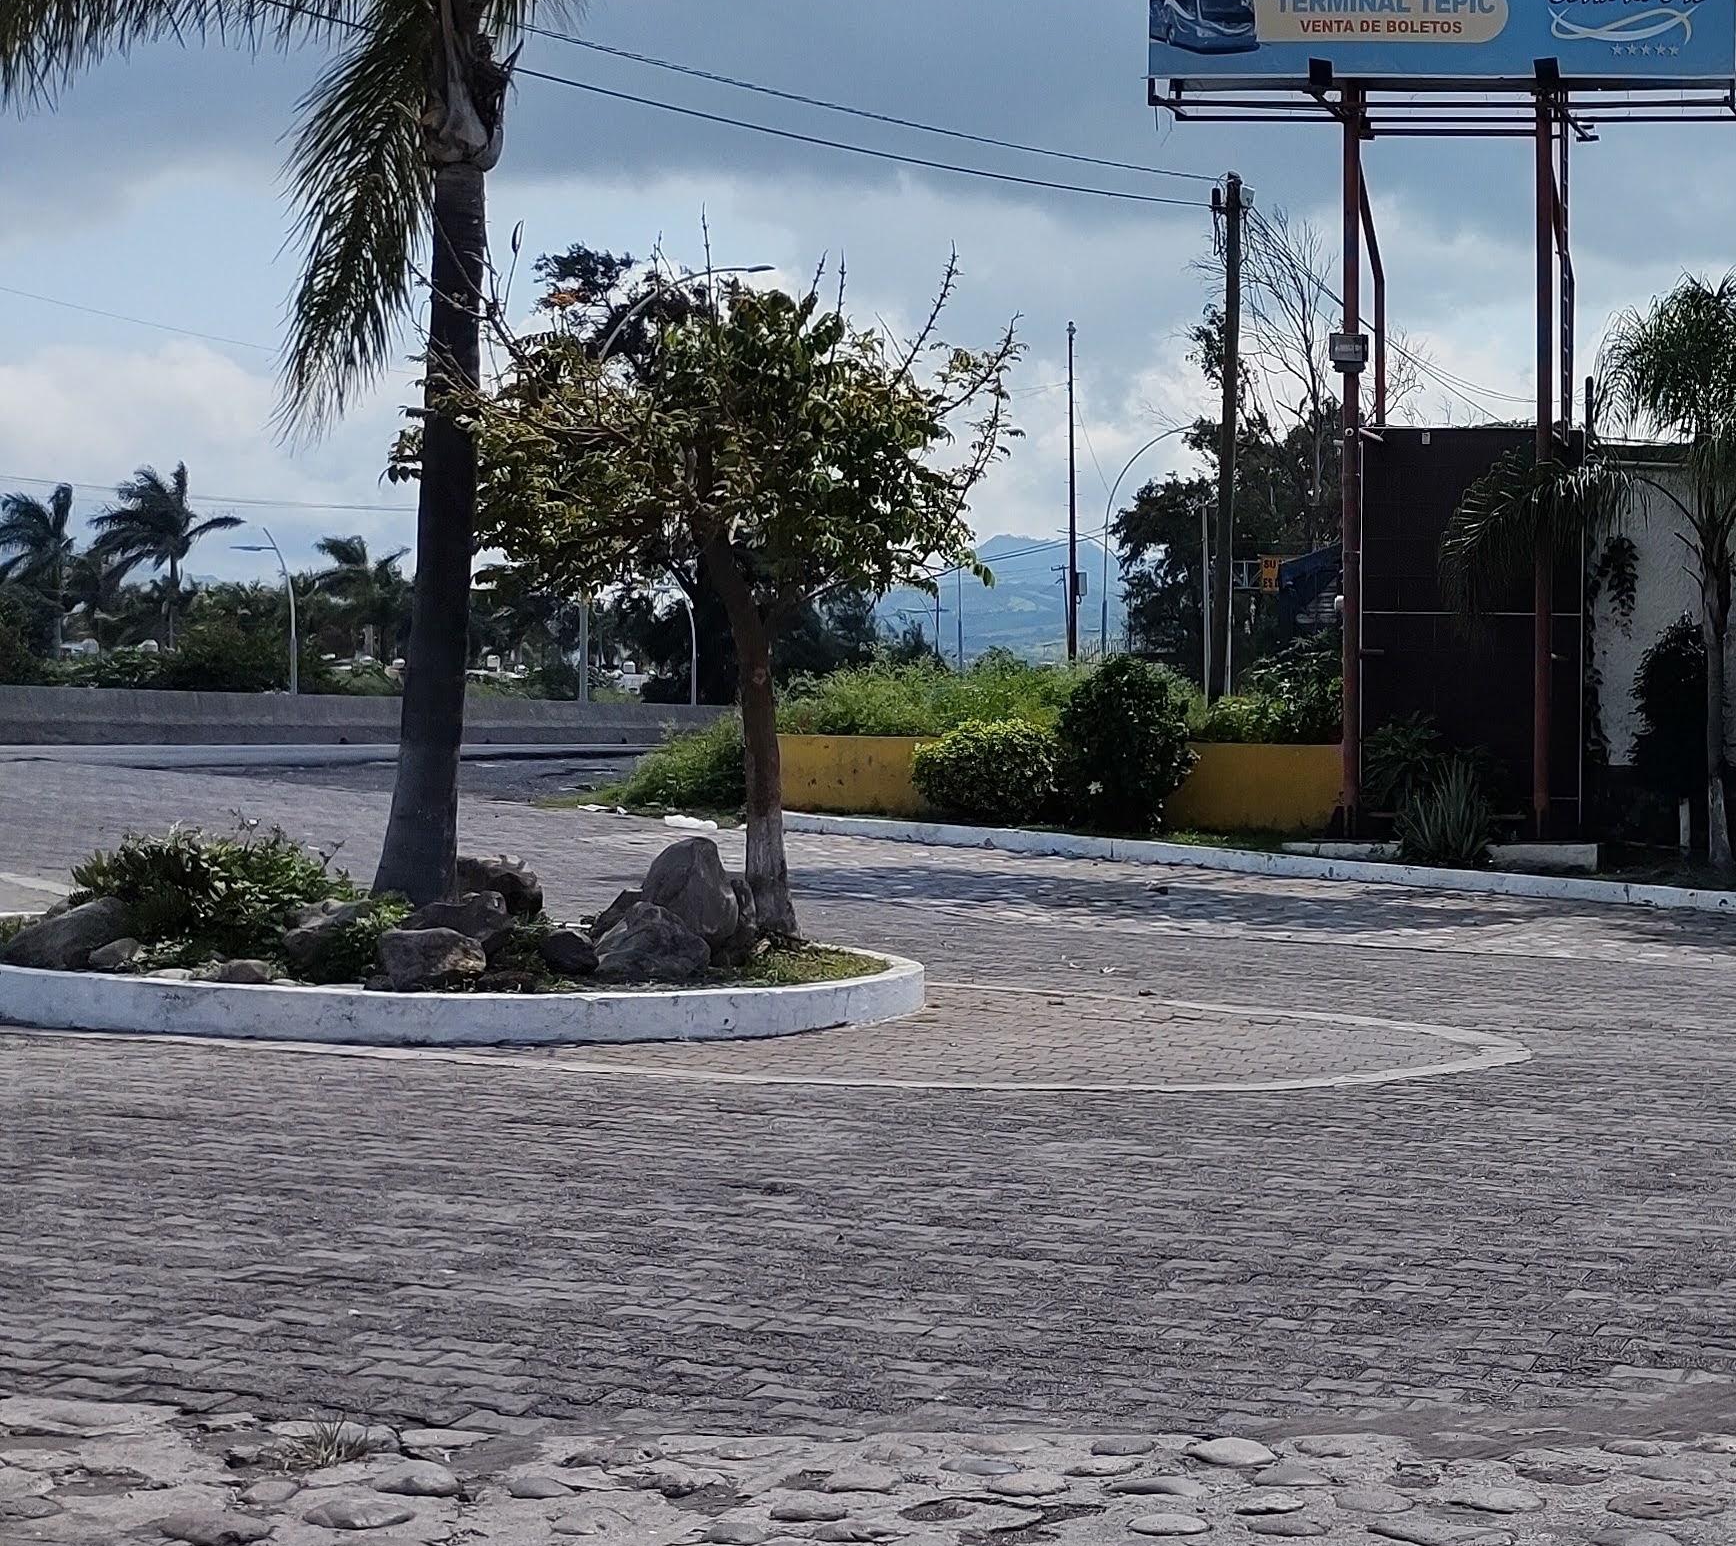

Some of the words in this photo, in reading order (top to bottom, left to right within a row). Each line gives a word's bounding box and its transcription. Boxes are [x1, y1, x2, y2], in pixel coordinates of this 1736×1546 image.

[1299, 19, 1355, 34] VENTA
[1360, 19, 1381, 34] DE
[1386, 20, 1463, 34] BOLETOS
